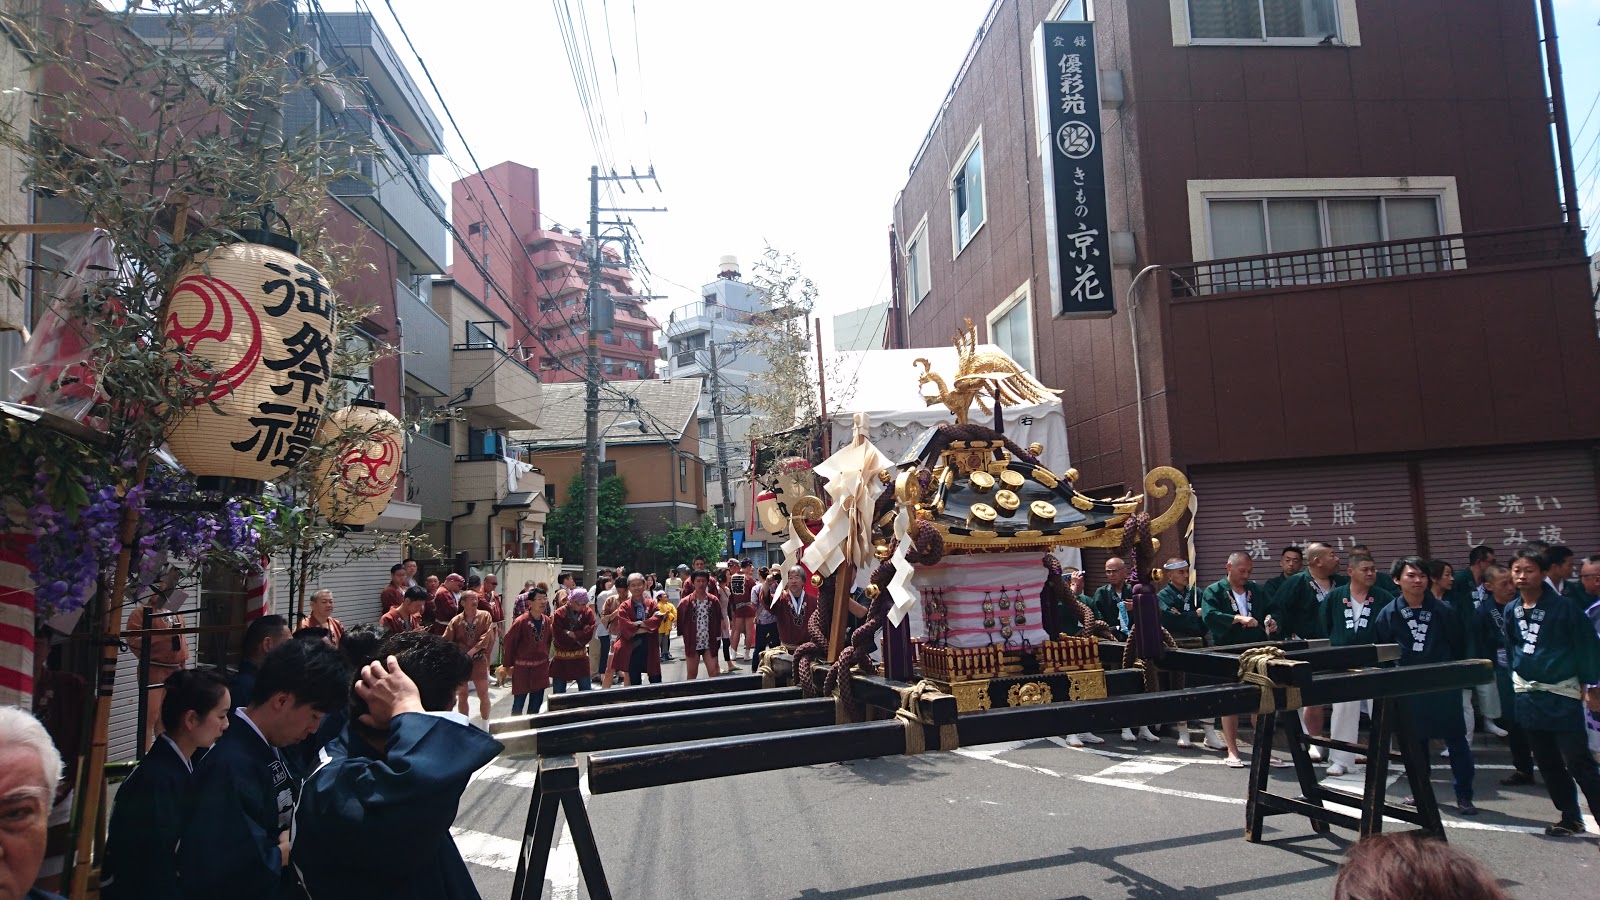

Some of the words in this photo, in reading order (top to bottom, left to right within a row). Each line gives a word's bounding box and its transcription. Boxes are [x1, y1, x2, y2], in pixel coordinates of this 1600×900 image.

[1058, 53, 1087, 115] 優彩苑
[1242, 502, 1356, 530] 京呉服
[1459, 493, 1562, 518] 生洗い
